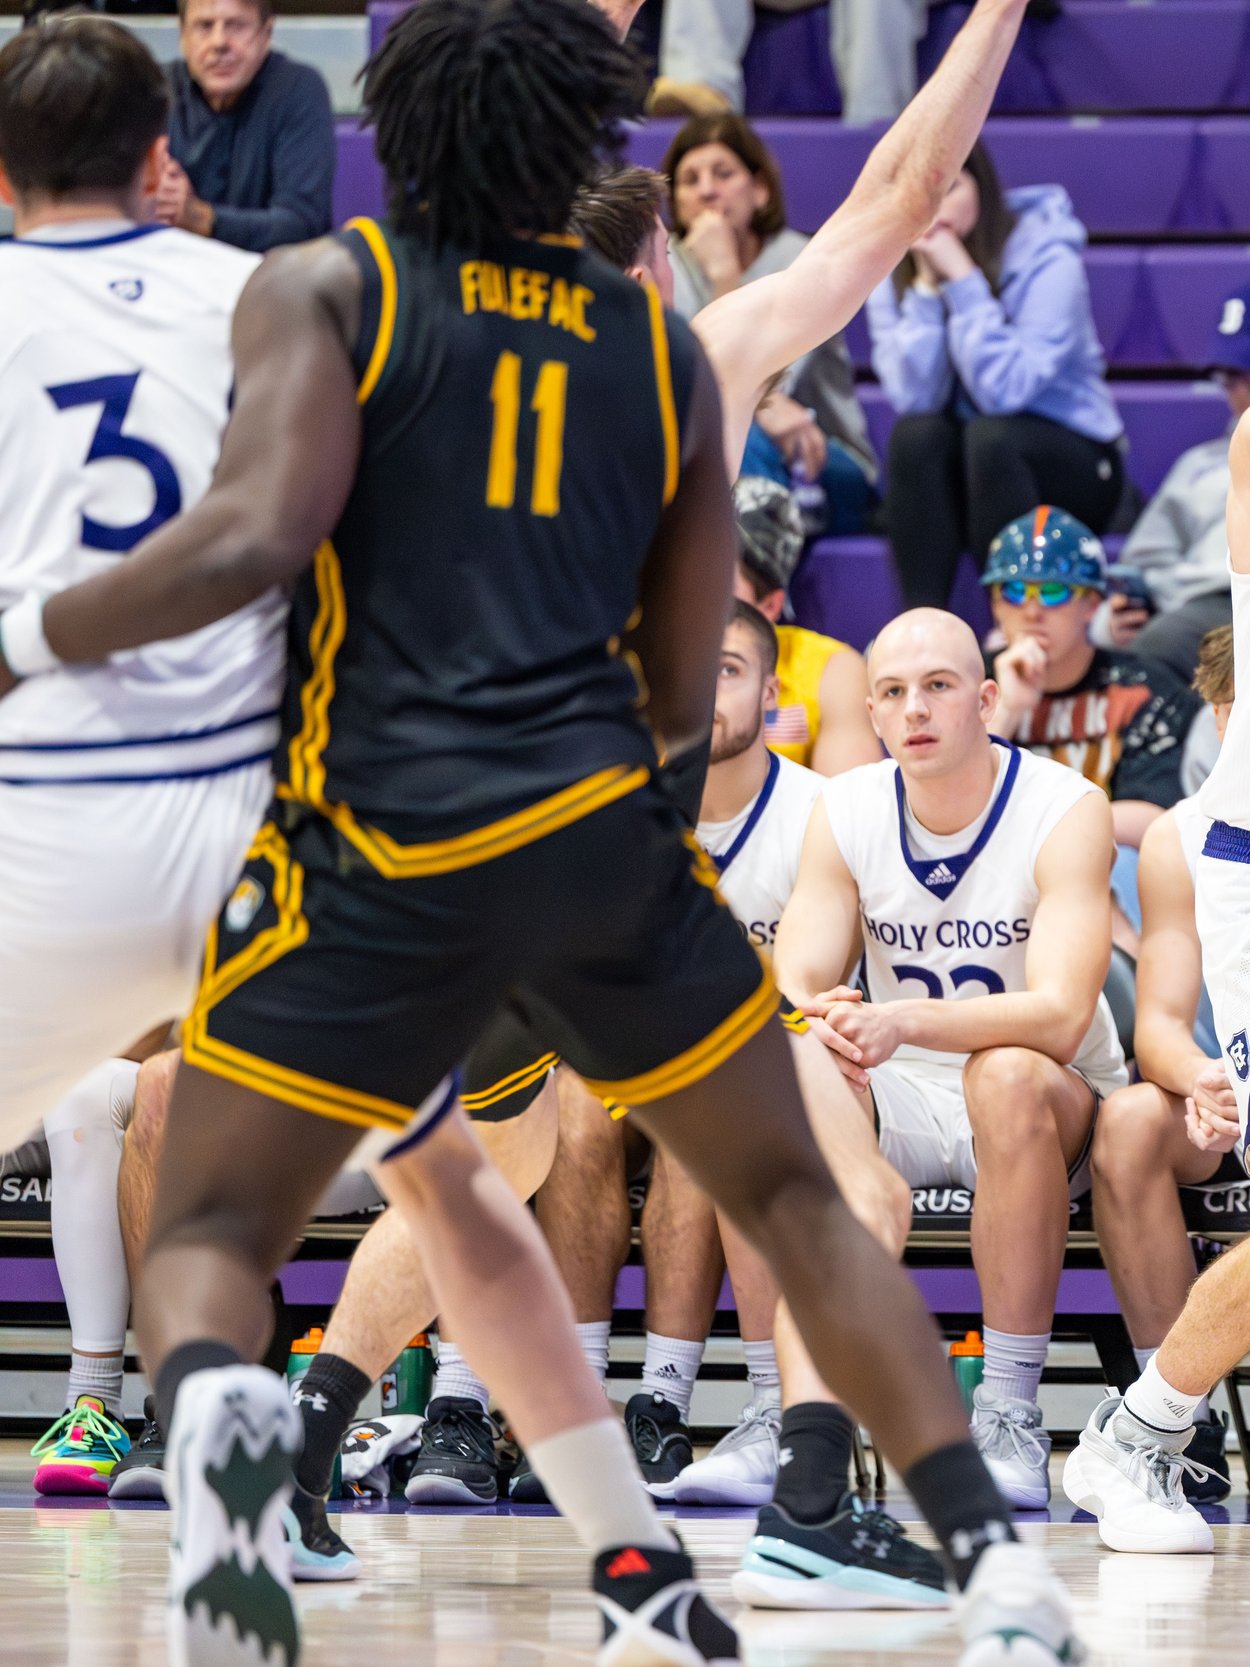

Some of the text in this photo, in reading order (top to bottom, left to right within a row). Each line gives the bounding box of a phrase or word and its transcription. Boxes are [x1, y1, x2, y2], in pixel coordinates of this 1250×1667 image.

[485, 350, 568, 518] 11
[44, 366, 184, 555] 3
[925, 873, 957, 886] adidas
[863, 912, 1031, 952] HOLY CROSS
[911, 1188, 975, 1214] RUS
